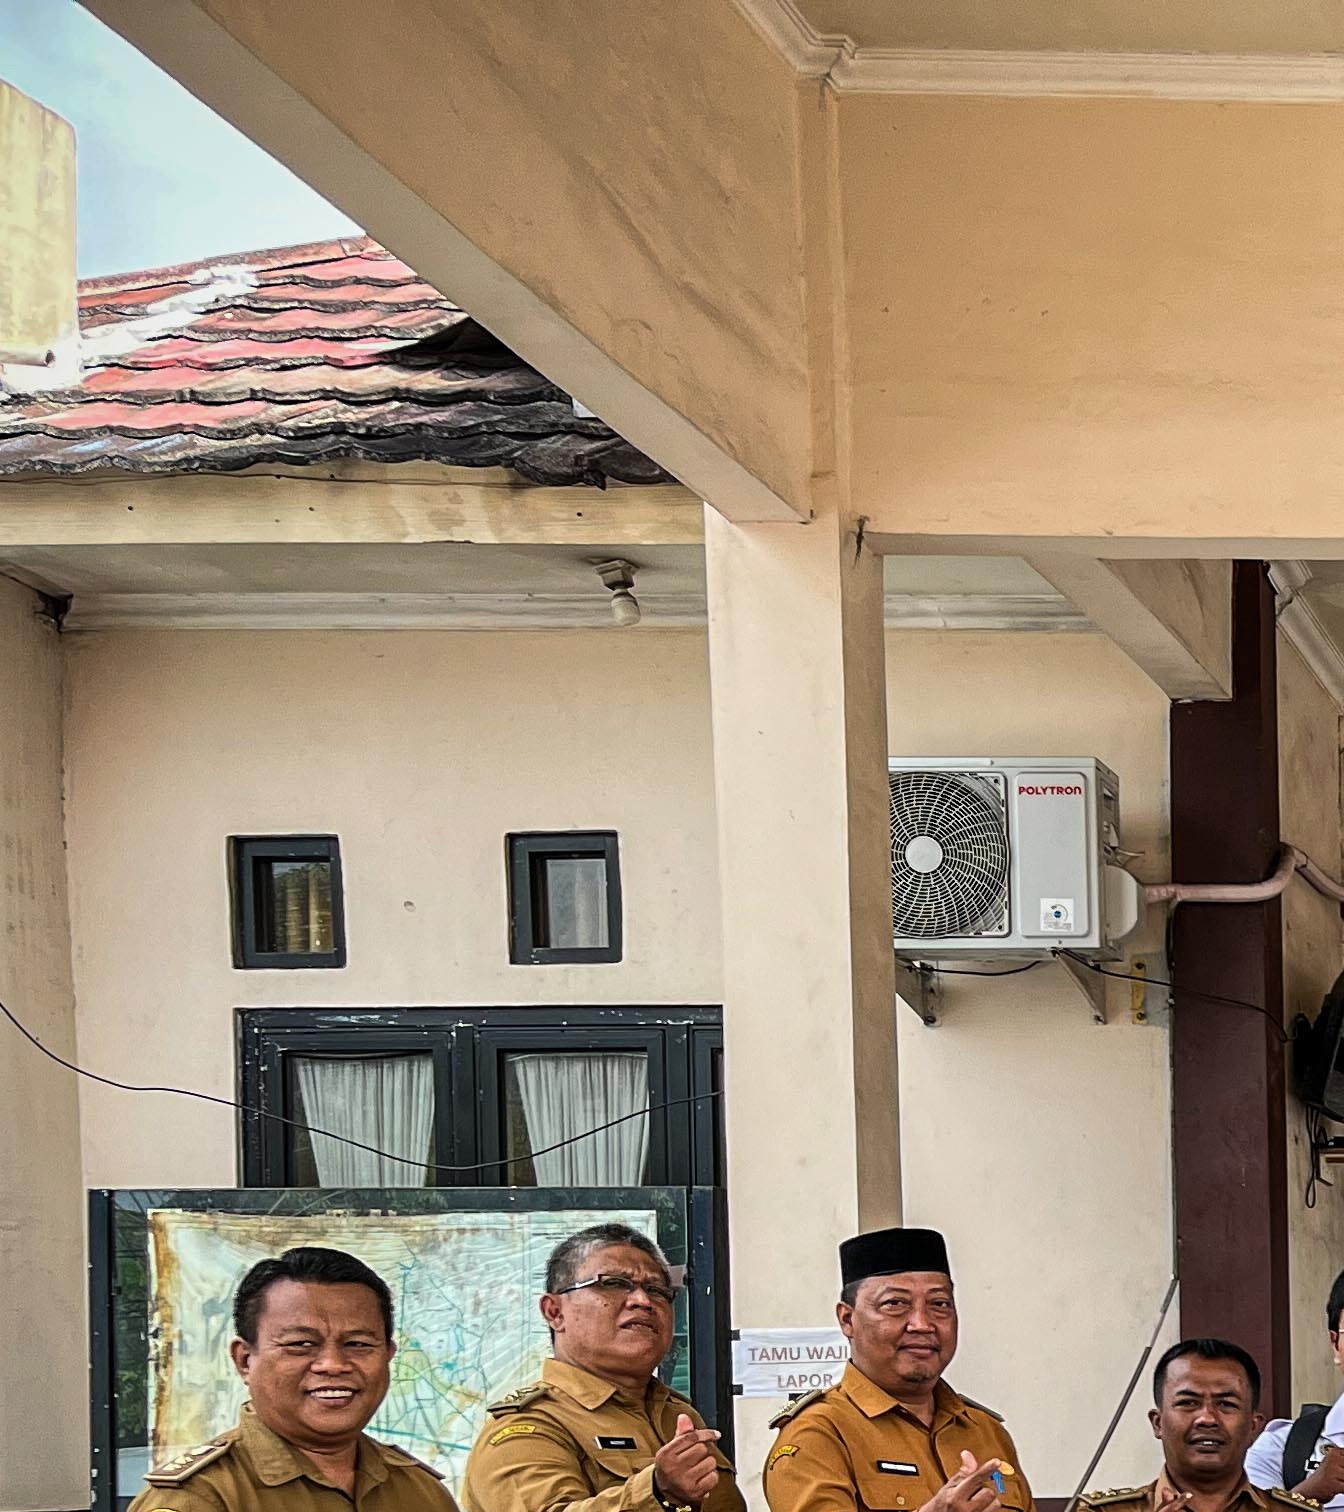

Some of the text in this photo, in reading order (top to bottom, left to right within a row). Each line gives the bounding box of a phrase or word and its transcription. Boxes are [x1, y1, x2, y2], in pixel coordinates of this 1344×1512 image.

[1018, 785, 1082, 796] POLYTRON
[747, 1345, 848, 1361] TAMU WAJI
[777, 1373, 834, 1388] LAPOR
